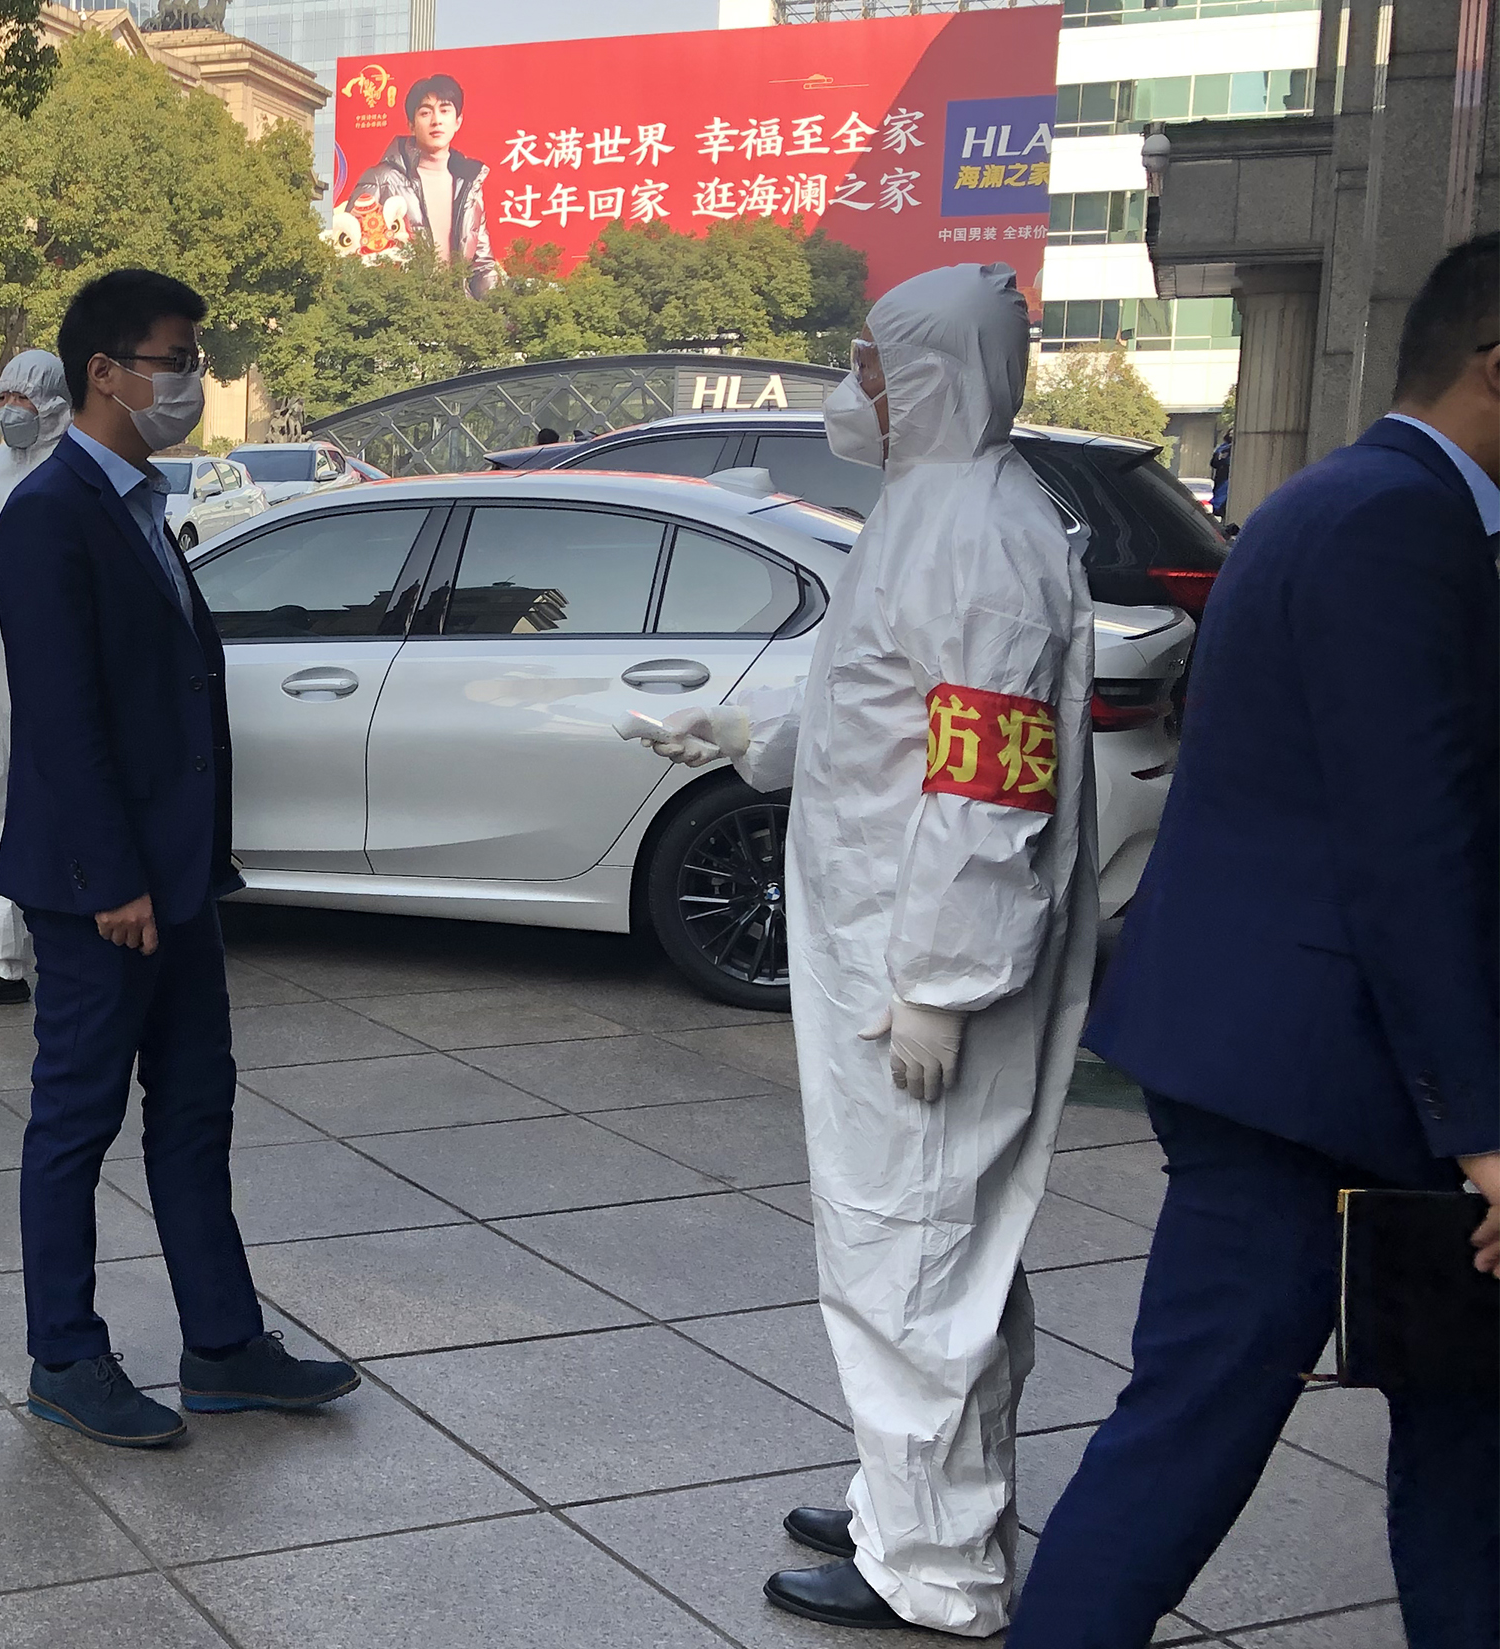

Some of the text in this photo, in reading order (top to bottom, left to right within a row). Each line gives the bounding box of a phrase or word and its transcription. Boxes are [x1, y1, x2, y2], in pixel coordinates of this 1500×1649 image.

[500, 108, 926, 173] 衣满世界 幸福至全家
[961, 122, 1052, 159] HLA
[954, 161, 1050, 190] 海澜之家
[499, 167, 922, 228] 过年回家 逛海澜之家
[938, 227, 998, 243] 中国男装
[691, 373, 789, 409] HLA
[927, 694, 1057, 797] 防疫
